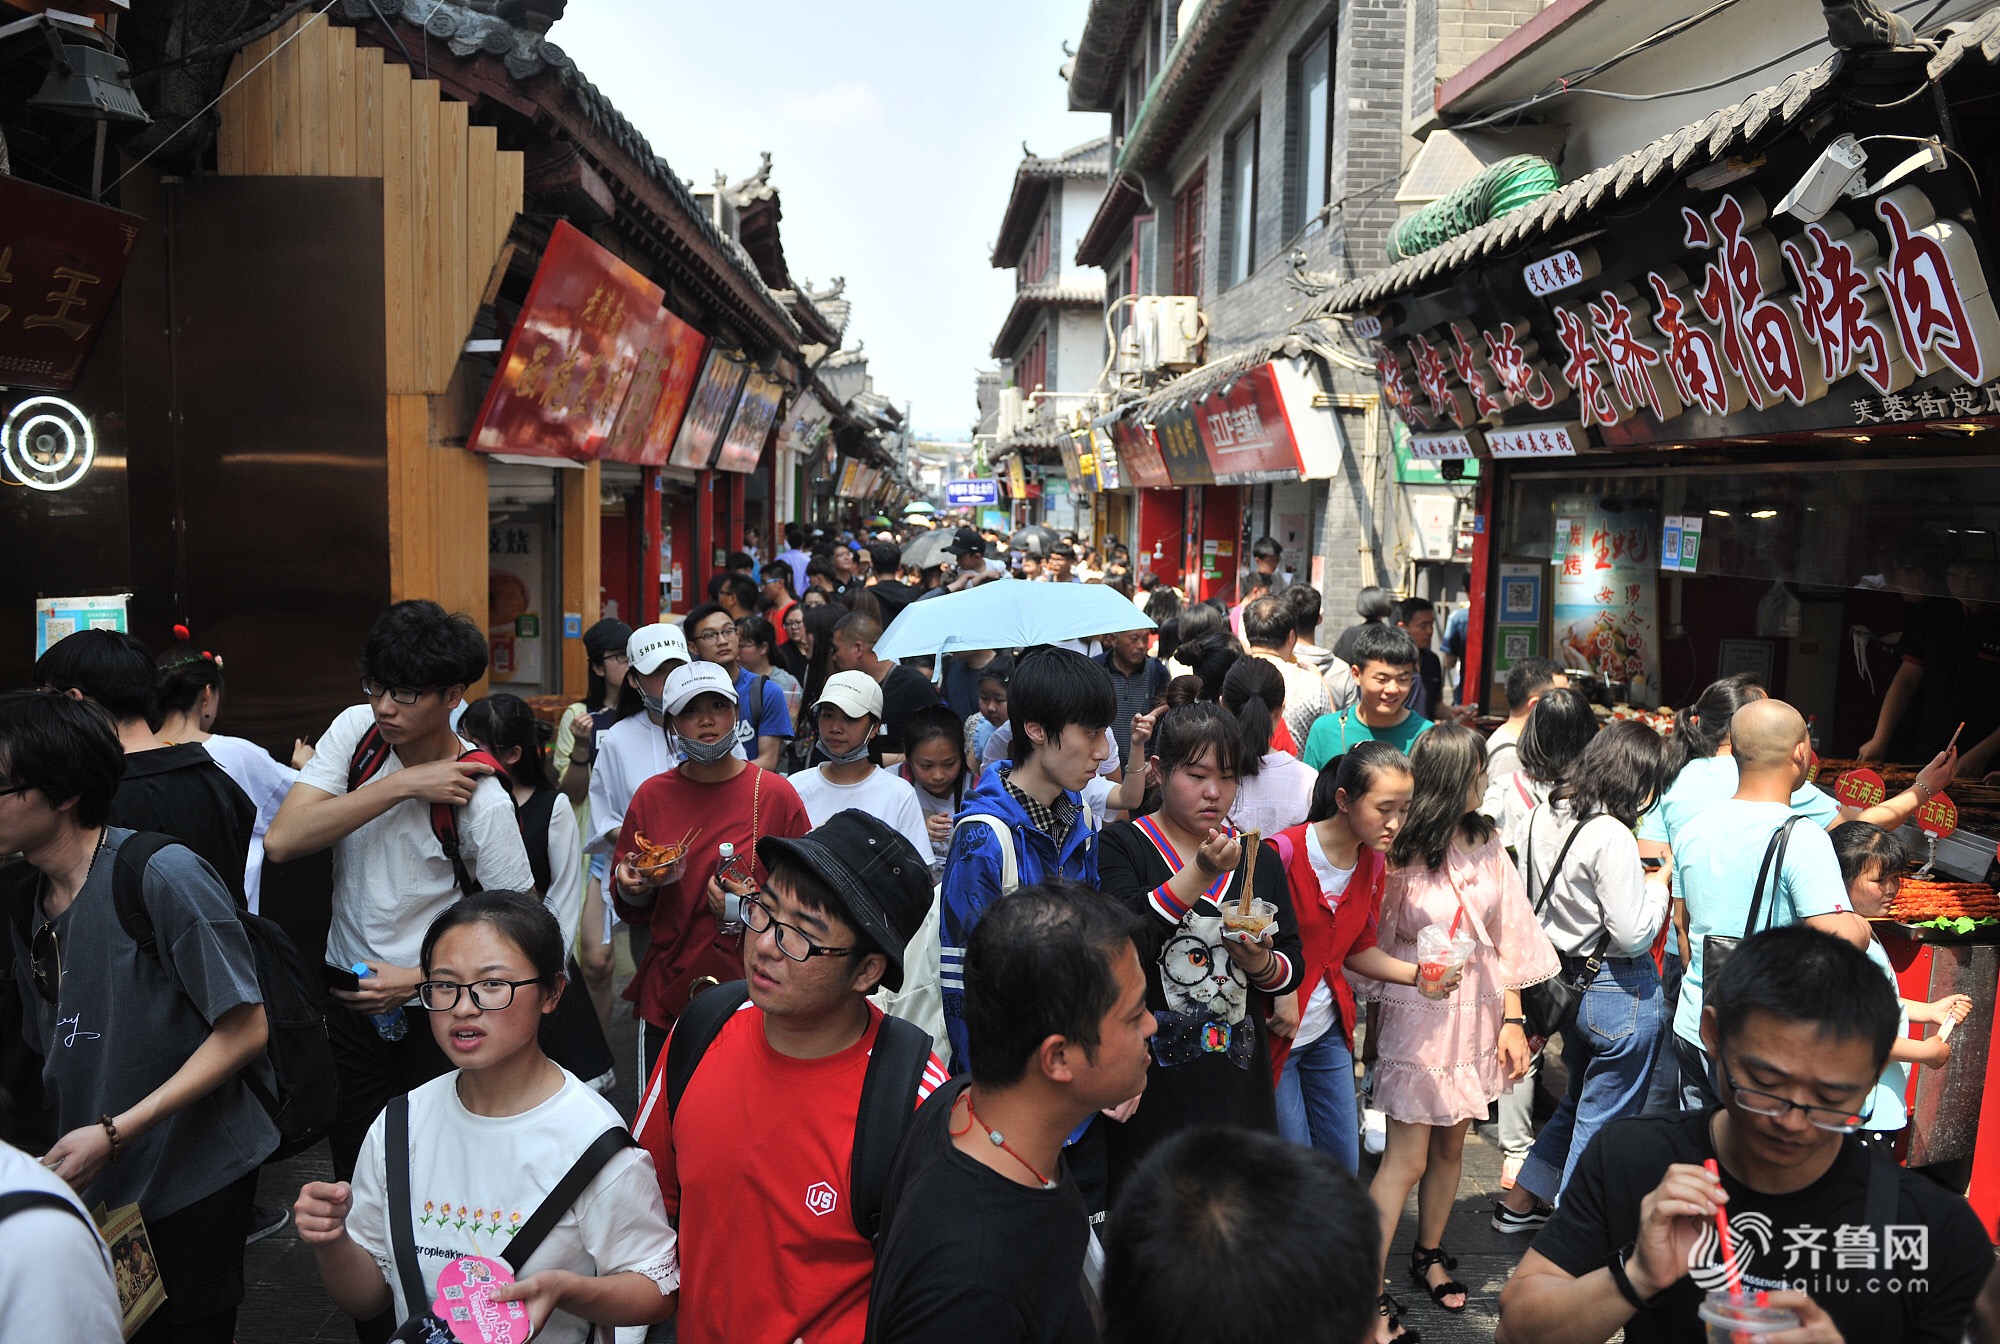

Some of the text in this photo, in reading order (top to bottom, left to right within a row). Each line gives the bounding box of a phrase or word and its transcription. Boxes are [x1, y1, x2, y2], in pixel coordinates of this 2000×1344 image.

[1838, 771, 1883, 807] 十五两串
[810, 1189, 833, 1209] US
